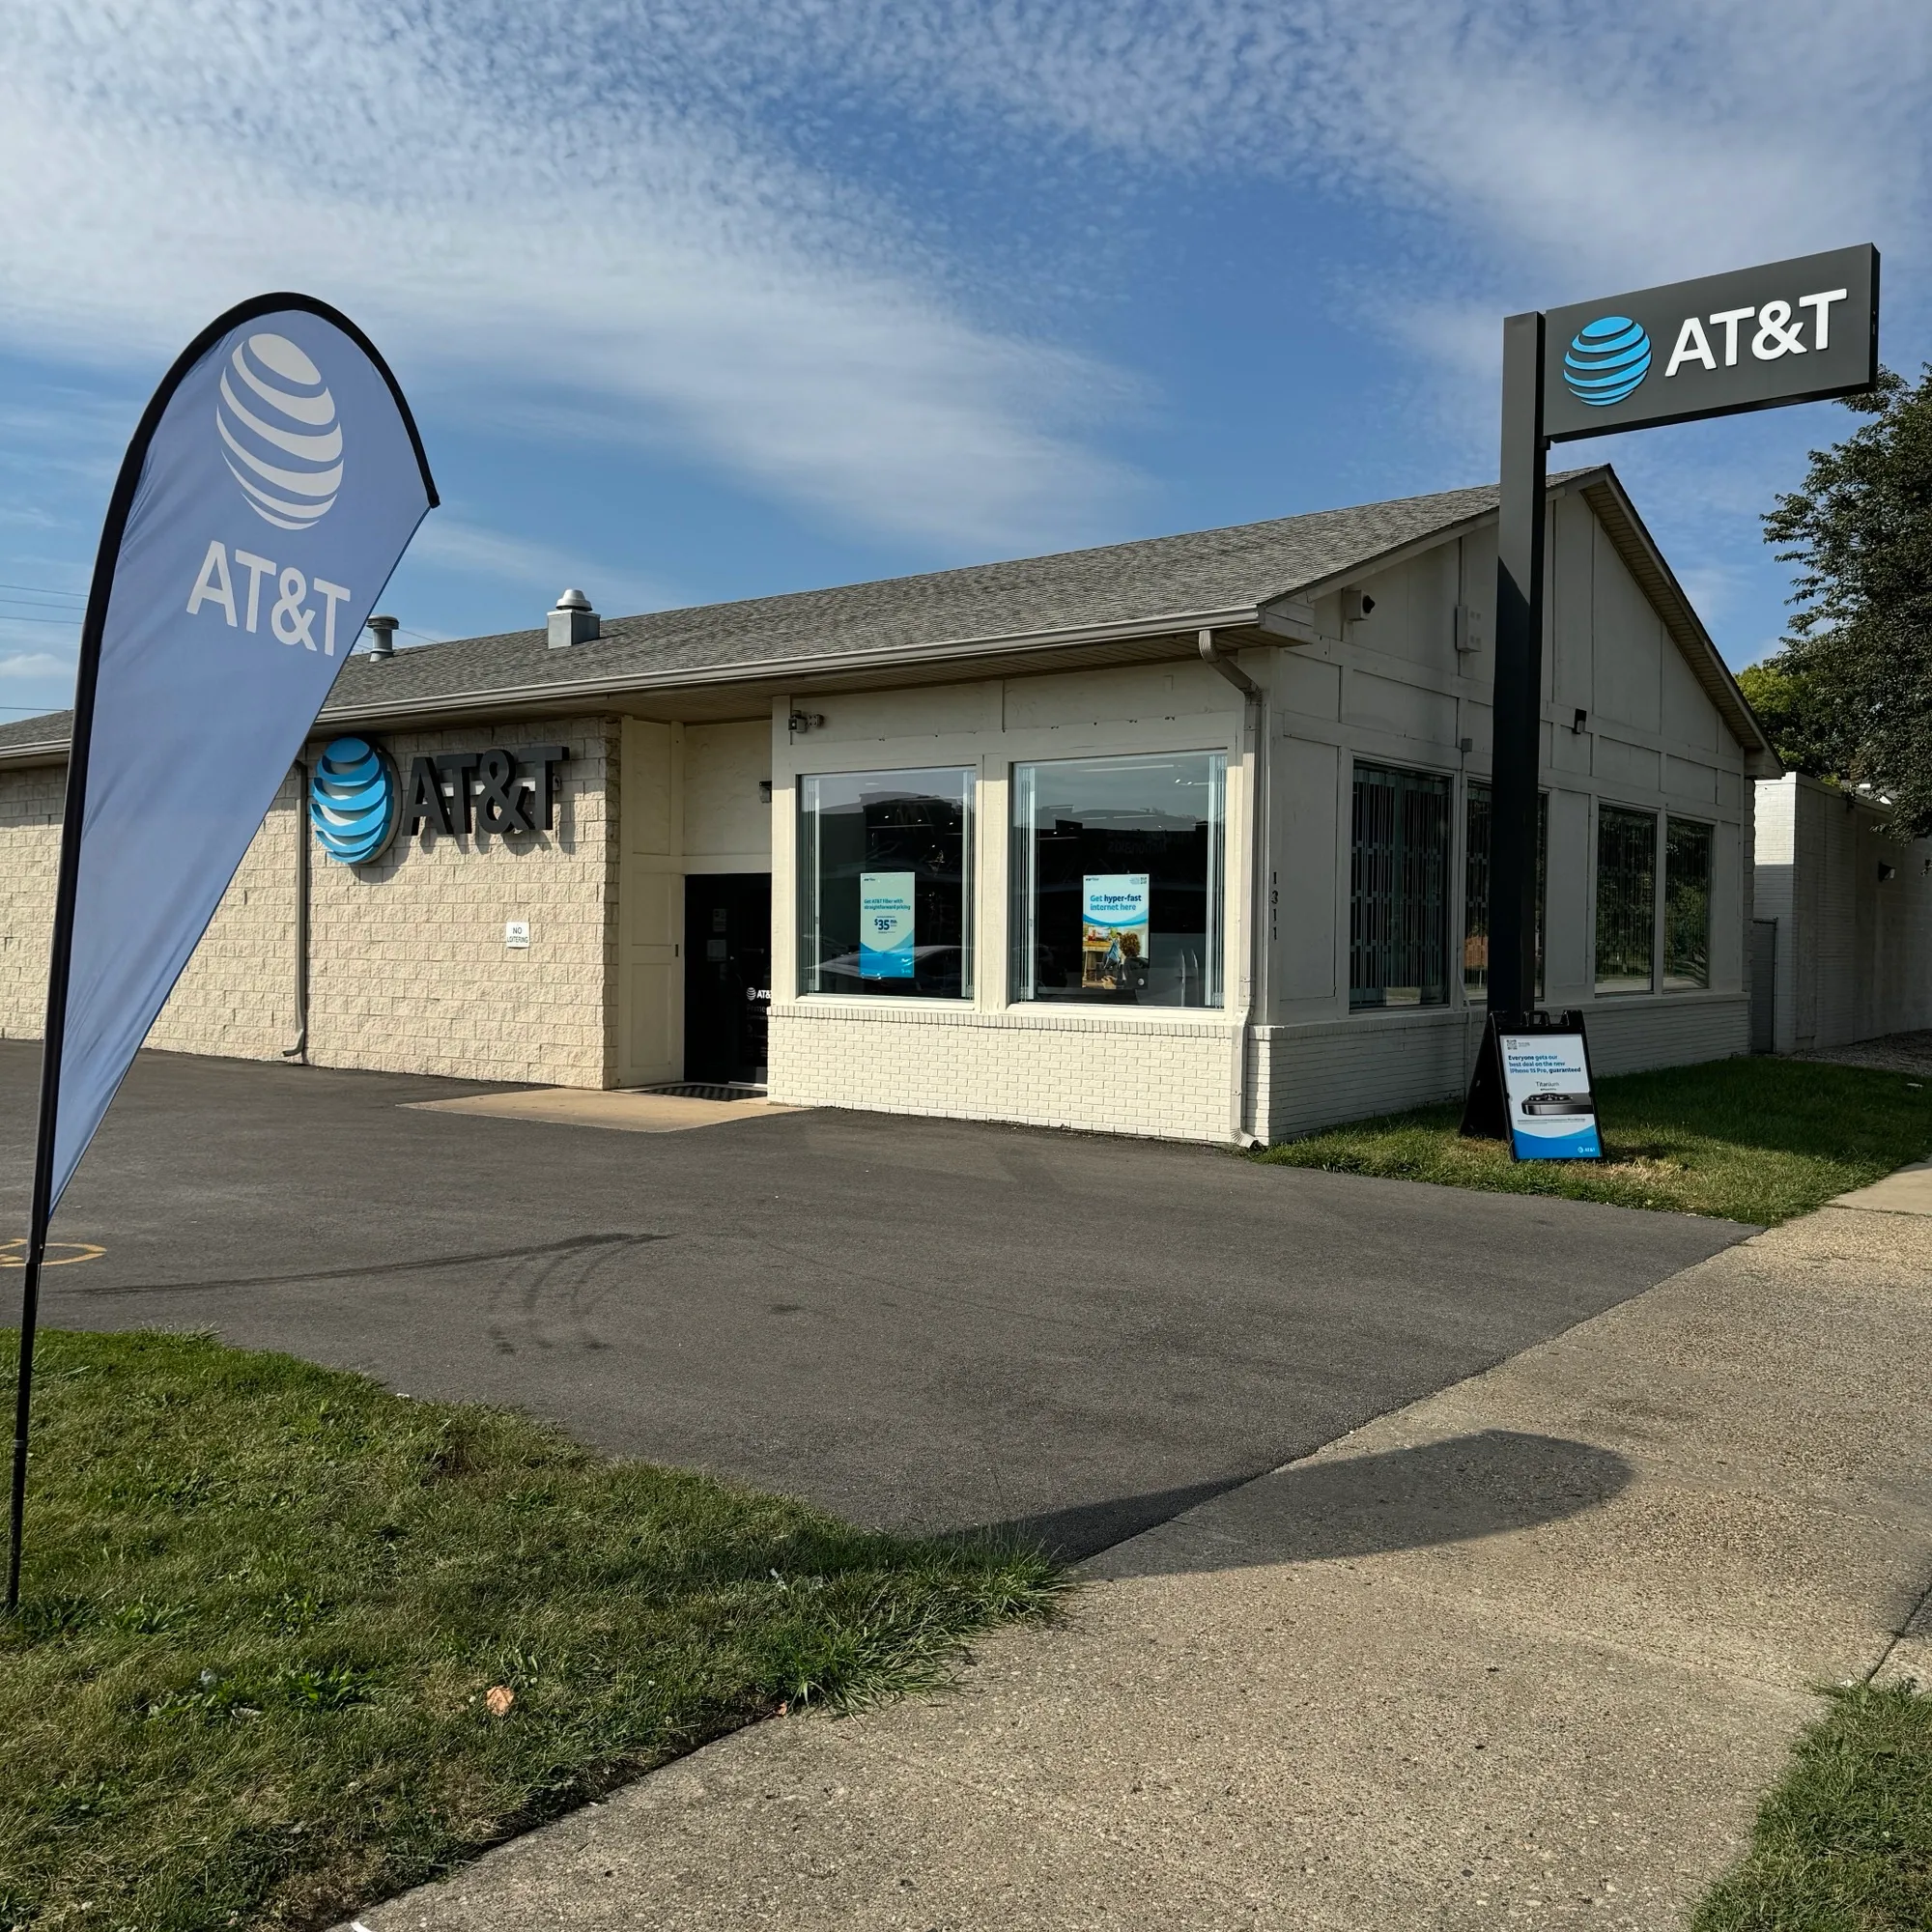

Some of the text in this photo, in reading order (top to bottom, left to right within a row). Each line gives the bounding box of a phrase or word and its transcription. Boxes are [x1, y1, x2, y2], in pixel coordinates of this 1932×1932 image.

[1664, 288, 1847, 378] AT&T
[186, 540, 351, 657] AT&T
[402, 746, 569, 837] AT&T
[874, 918, 890, 930] $35
[1103, 894, 1142, 904] hyper-fast
